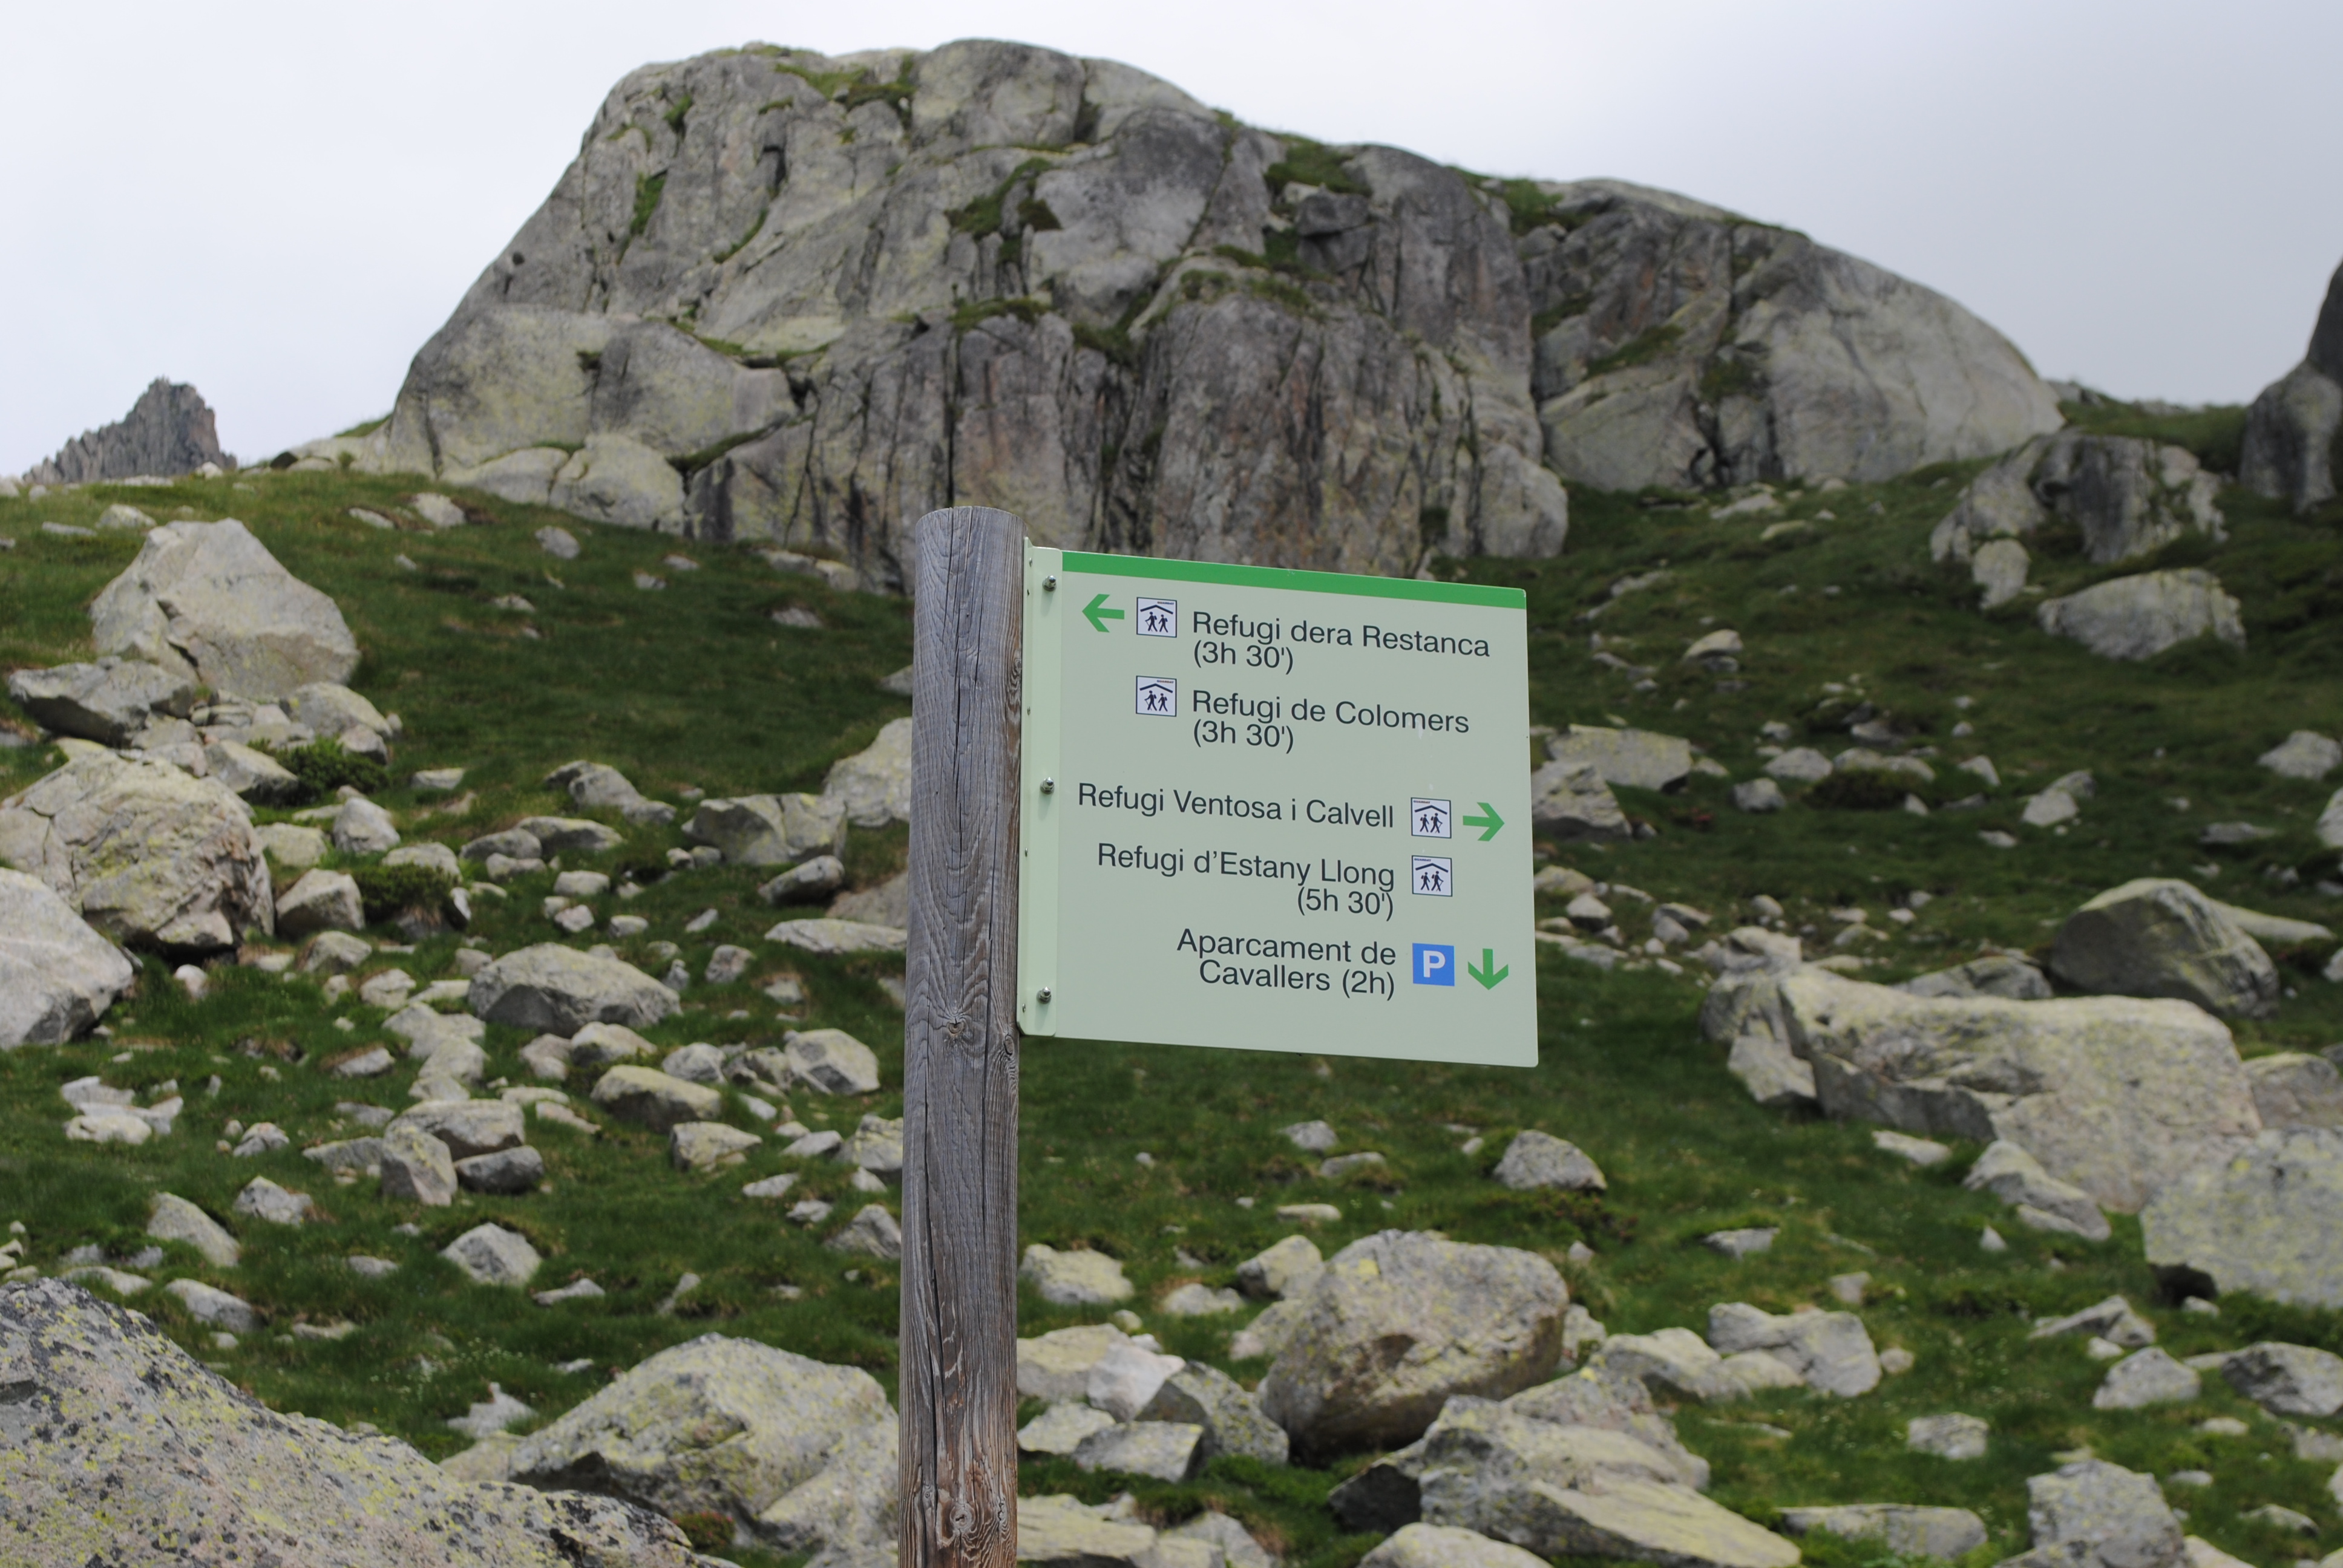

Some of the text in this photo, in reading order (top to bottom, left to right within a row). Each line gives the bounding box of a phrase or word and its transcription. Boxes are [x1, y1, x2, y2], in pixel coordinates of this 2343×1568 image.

[1193, 611, 1490, 658] Refugi dera Restanca
[1194, 639, 1294, 675] (3h 30')
[1193, 690, 1469, 733] Refugi de Colomers
[1193, 719, 1294, 754] (3h 30')
[1079, 782, 1394, 828] Refugi Ventosa i Calvell
[1098, 843, 1184, 877] Refugi
[1321, 858, 1395, 892] Llong
[1297, 886, 1394, 922] (5h 30')
[1176, 928, 1396, 965] Aparcament de
[1423, 950, 1446, 978] P
[1199, 959, 1394, 1001] Cavallers (2h)
